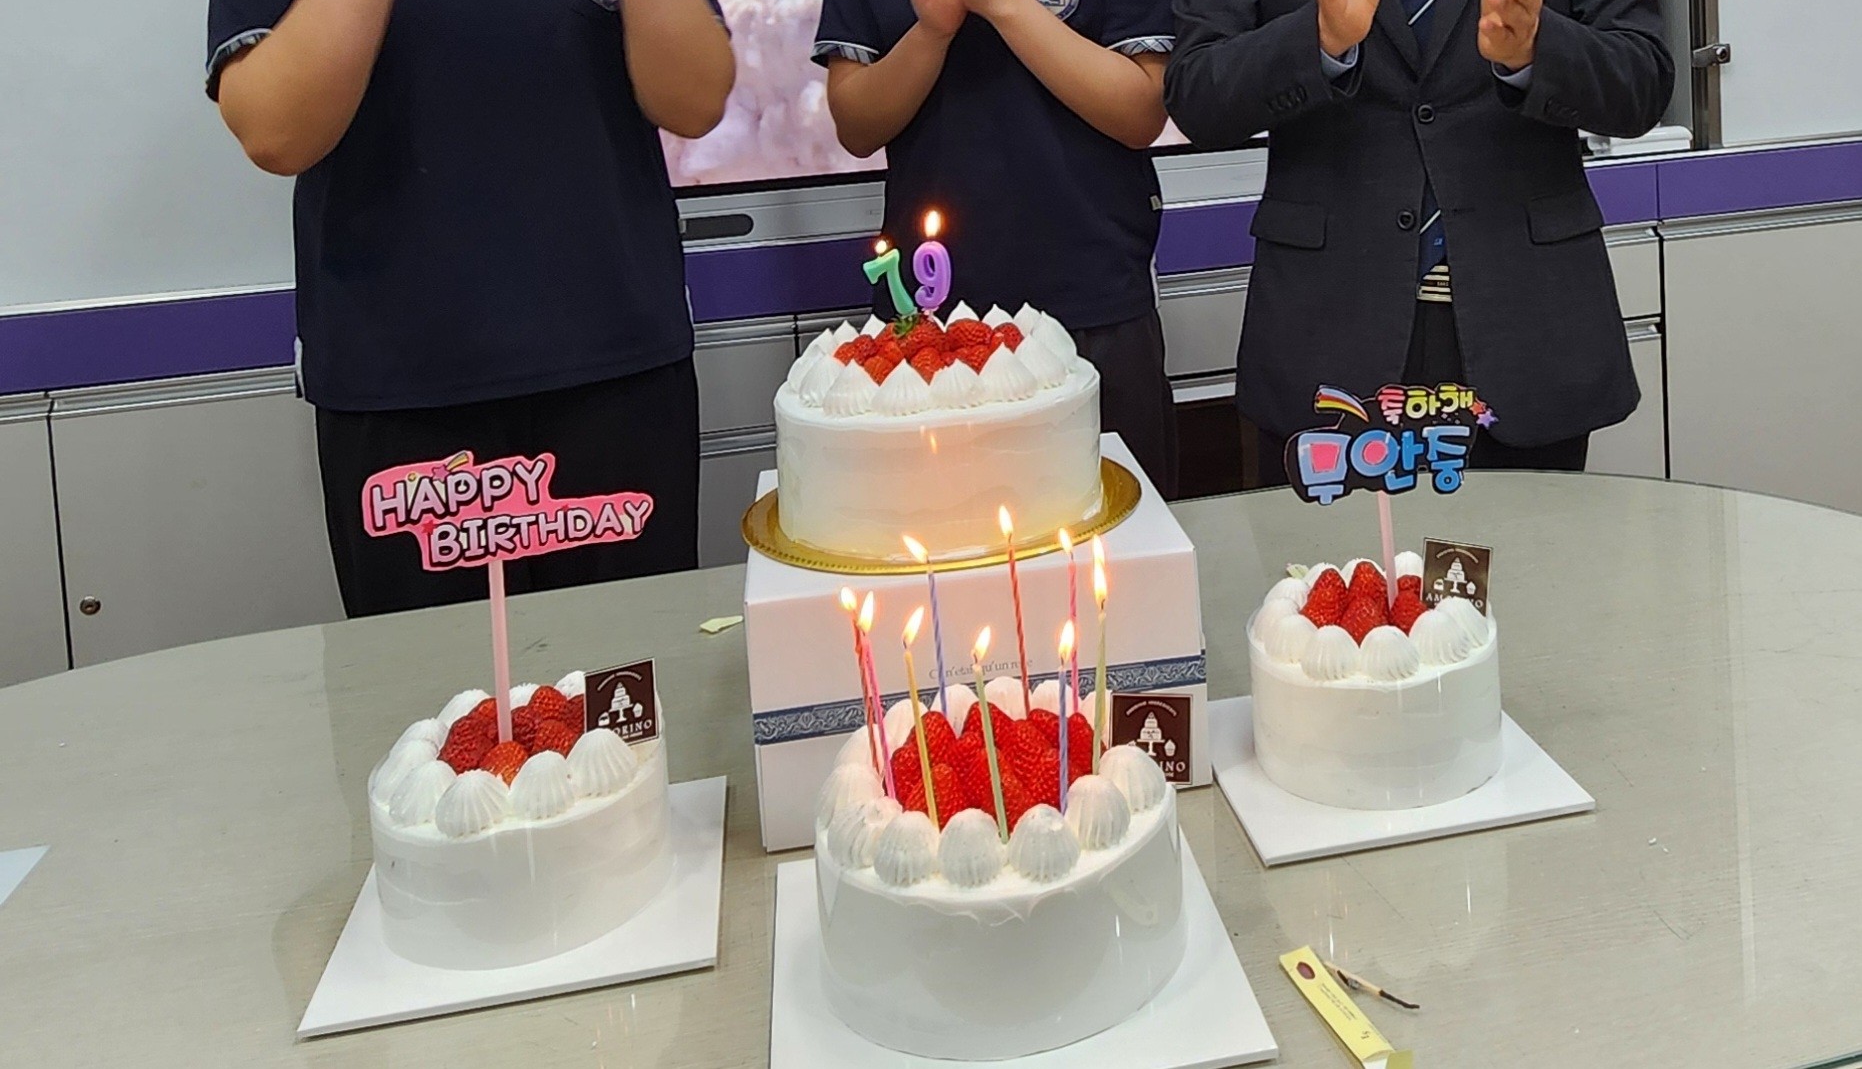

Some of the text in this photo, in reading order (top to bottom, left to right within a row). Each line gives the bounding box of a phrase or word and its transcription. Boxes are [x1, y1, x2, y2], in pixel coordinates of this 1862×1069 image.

[862, 240, 952, 315] 79
[1378, 384, 1473, 425] 축하해
[370, 460, 547, 529] HAPPY
[1298, 425, 1471, 505] 무안중
[430, 500, 650, 564] BIRTHDAY
[612, 719, 652, 737] ORINO
